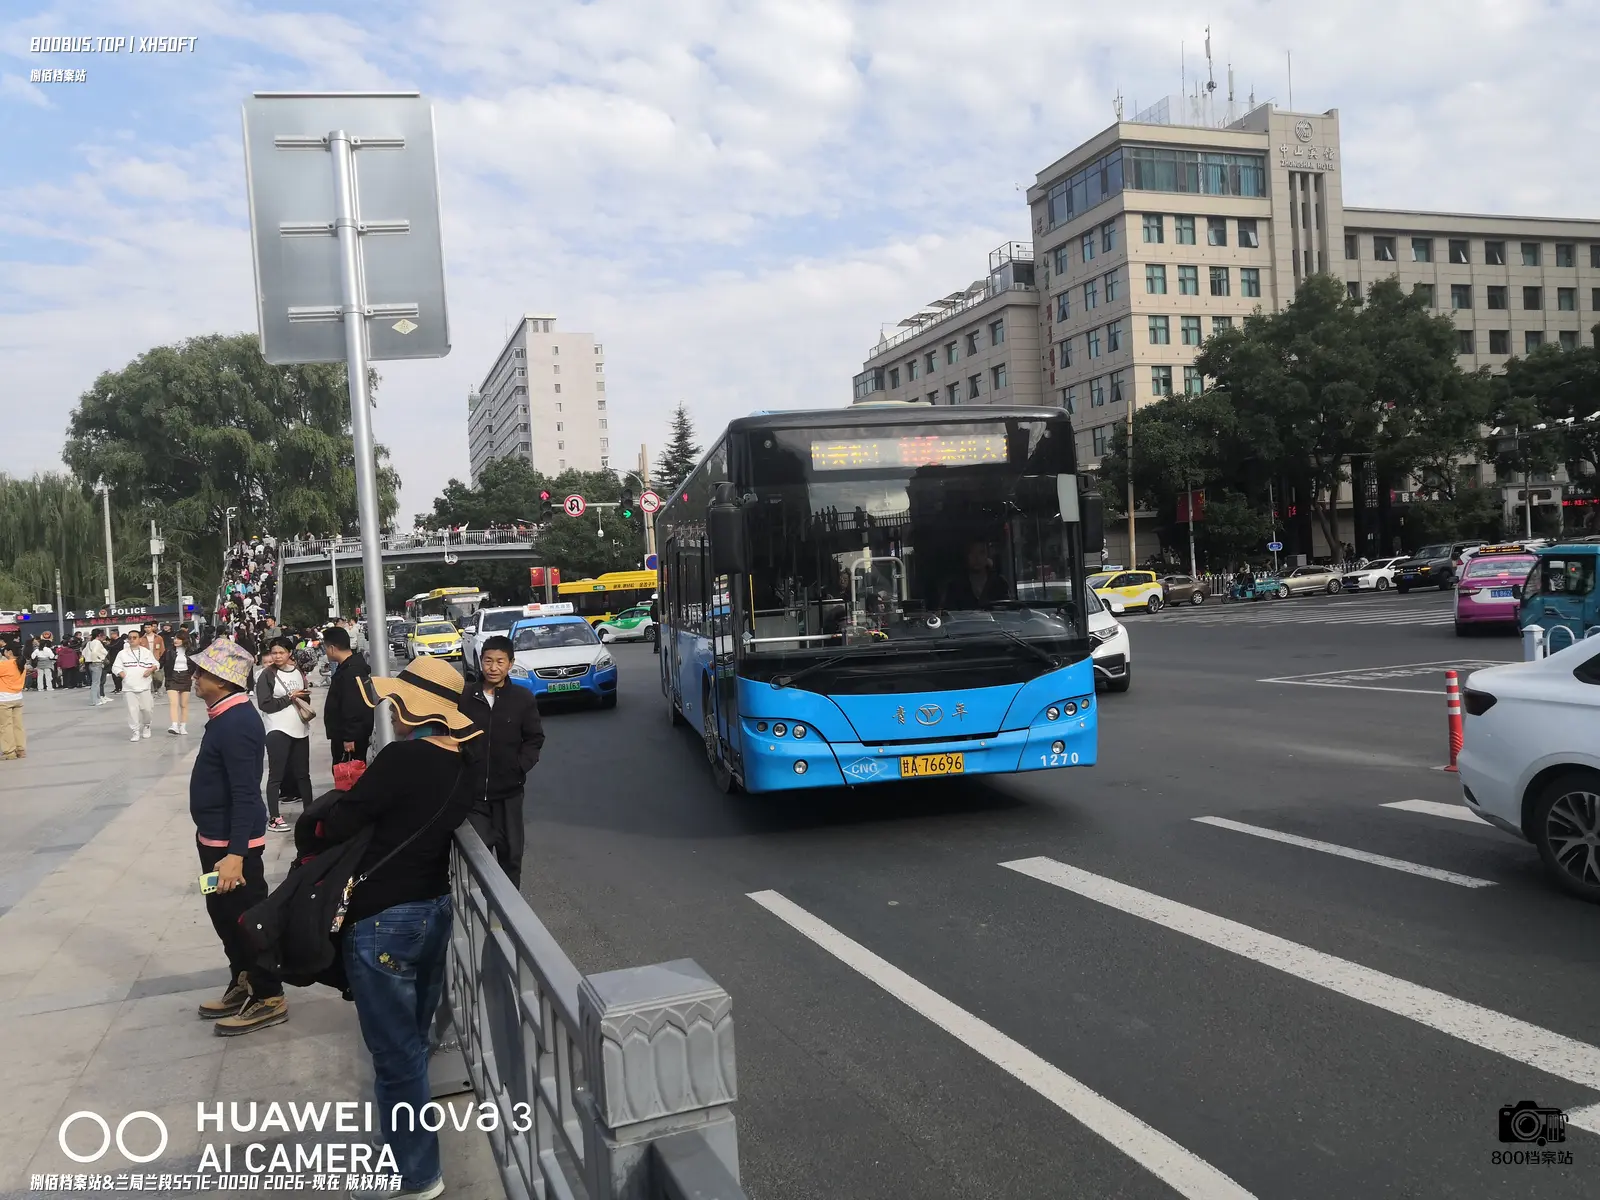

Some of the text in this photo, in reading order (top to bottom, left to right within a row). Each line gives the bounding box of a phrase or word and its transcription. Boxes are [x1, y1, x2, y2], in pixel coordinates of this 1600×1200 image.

[65, 607, 147, 620] 公安 POLICE
[1040, 752, 1080, 767] 1270
[851, 762, 878, 775] CNG
